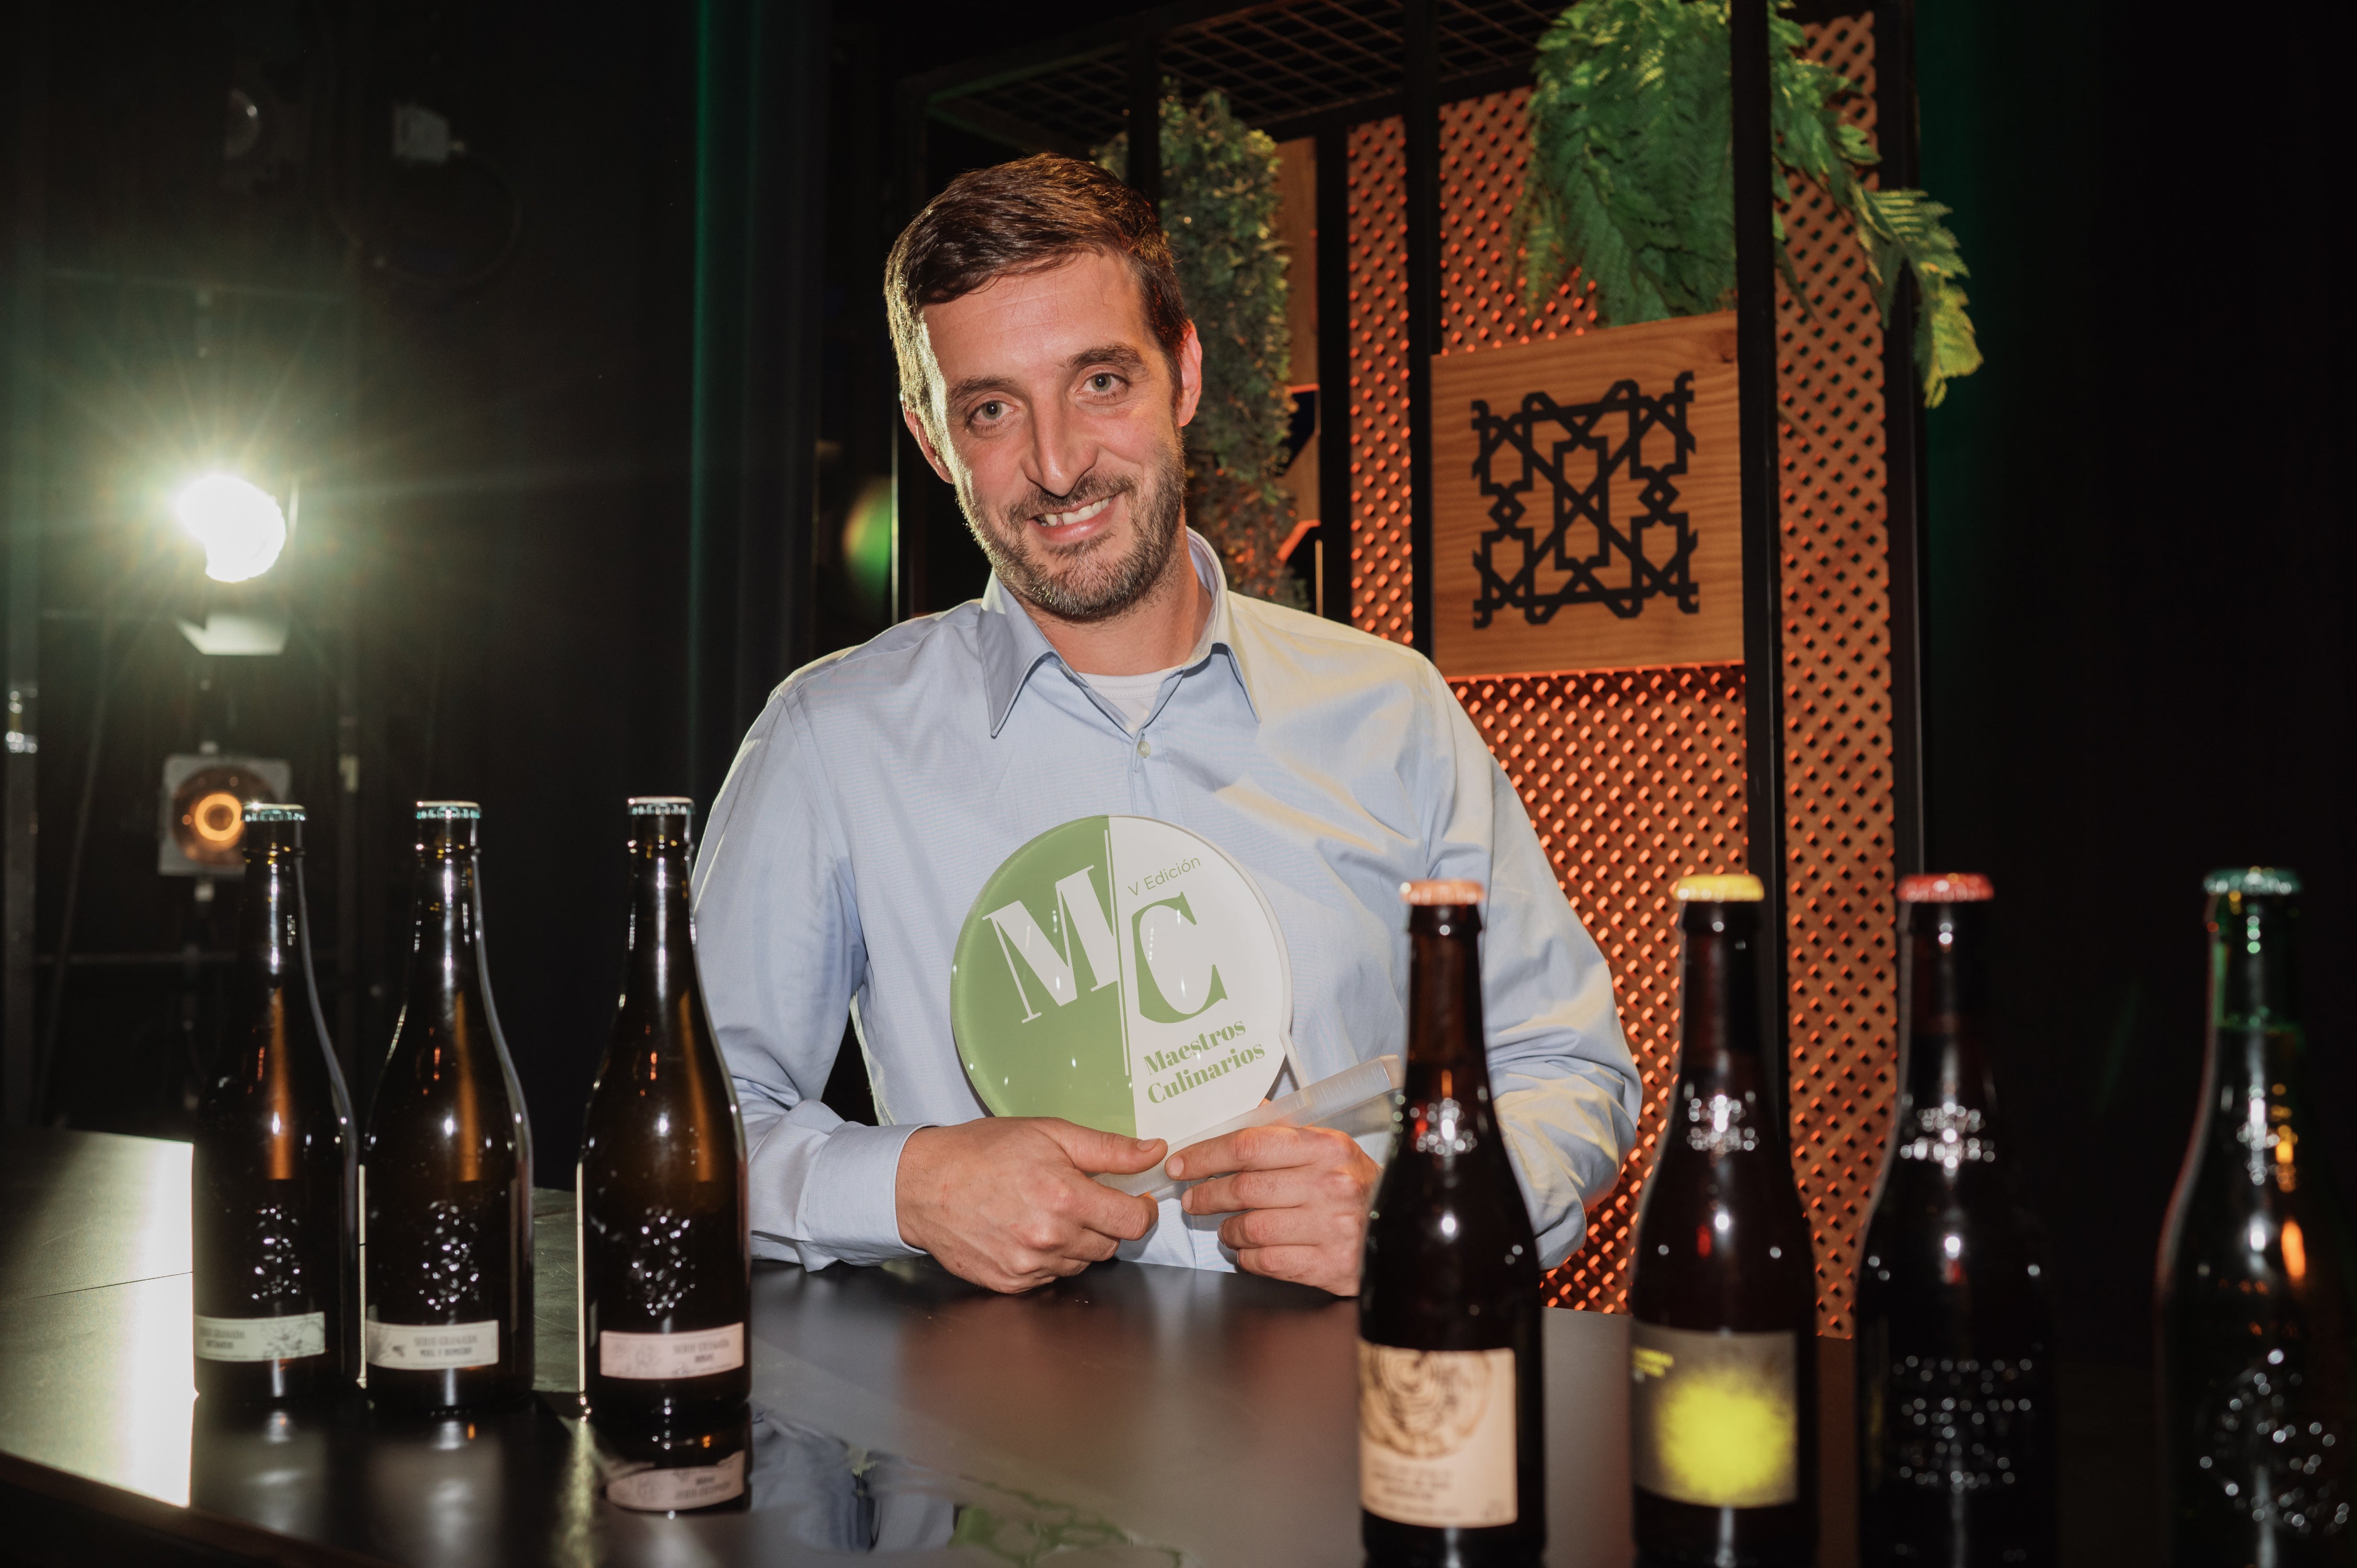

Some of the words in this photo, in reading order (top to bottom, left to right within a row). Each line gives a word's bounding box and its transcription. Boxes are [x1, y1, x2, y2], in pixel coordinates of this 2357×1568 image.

[1128, 882, 1138, 896] V
[1144, 858, 1201, 890] Edición
[1143, 1020, 1246, 1076] Maestros
[1147, 1043, 1265, 1104] Culinarios
